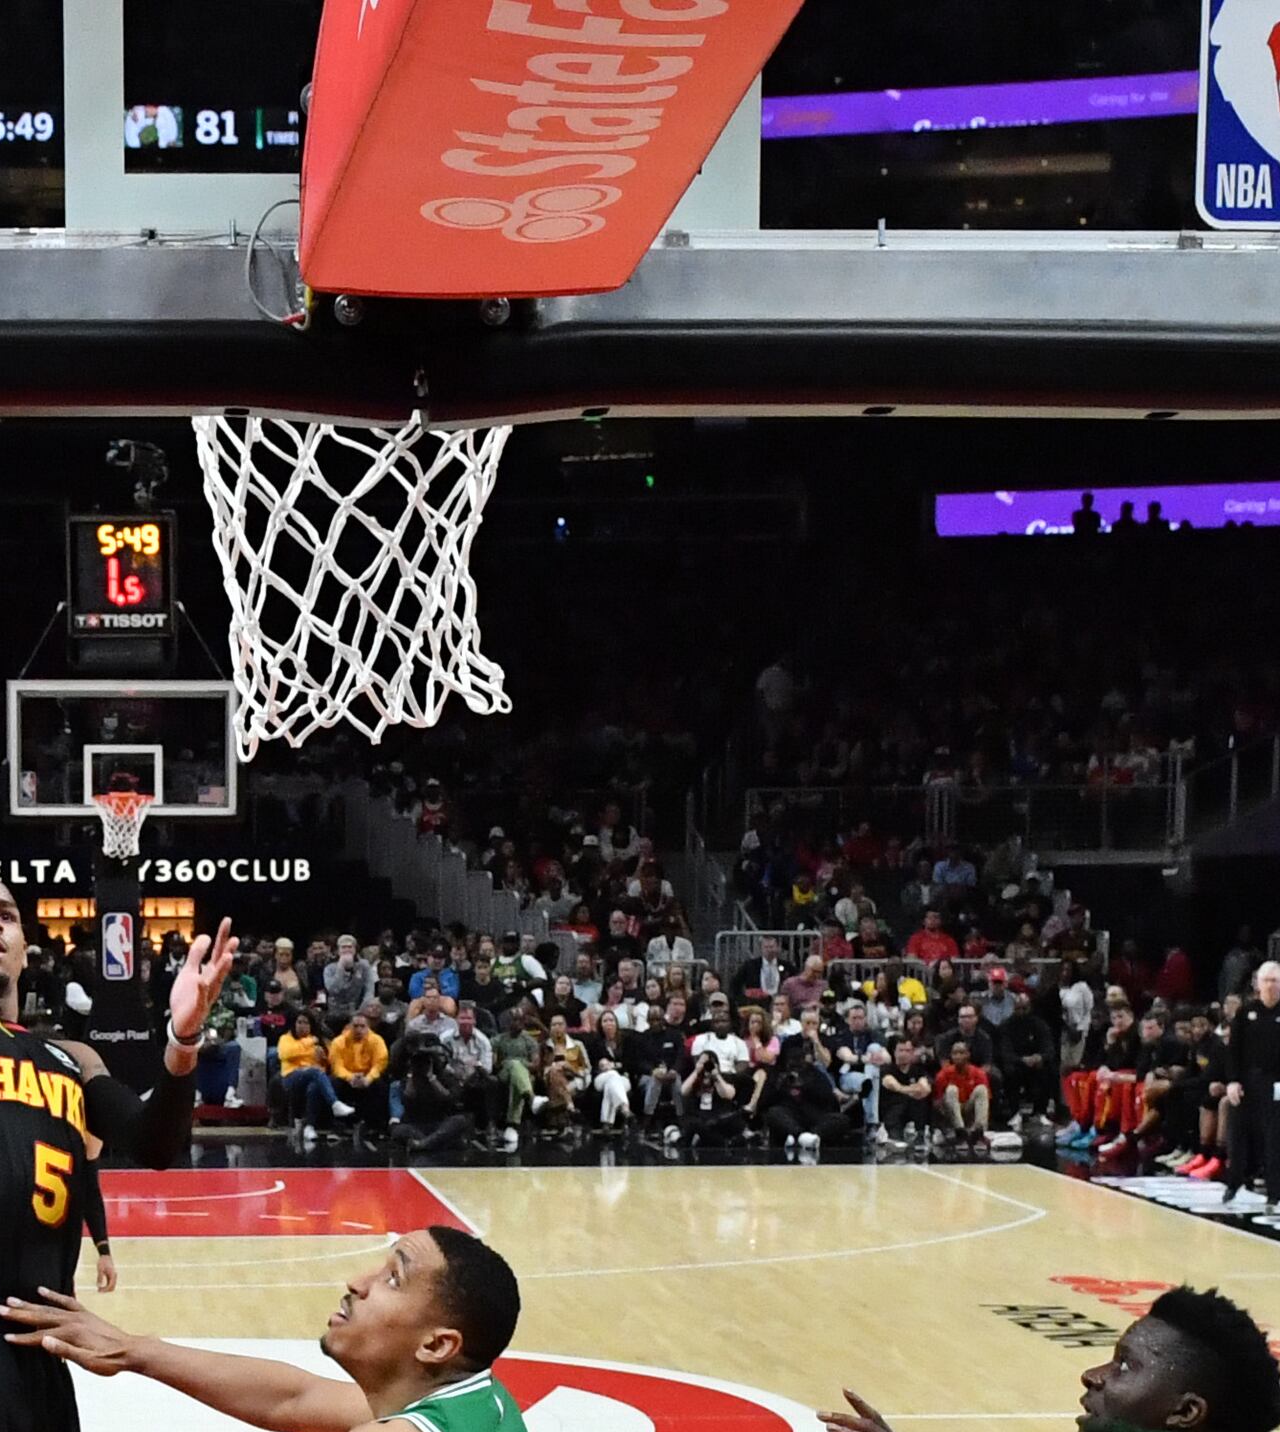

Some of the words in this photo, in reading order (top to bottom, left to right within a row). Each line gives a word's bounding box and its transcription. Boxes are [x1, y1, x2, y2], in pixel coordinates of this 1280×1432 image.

[195, 110, 239, 144] 81
[1216, 163, 1273, 209] NBA
[97, 524, 160, 555] 5:49
[101, 613, 168, 628] TISSOT
[90, 1030, 125, 1043] Google
[33, 1141, 73, 1226] 5
